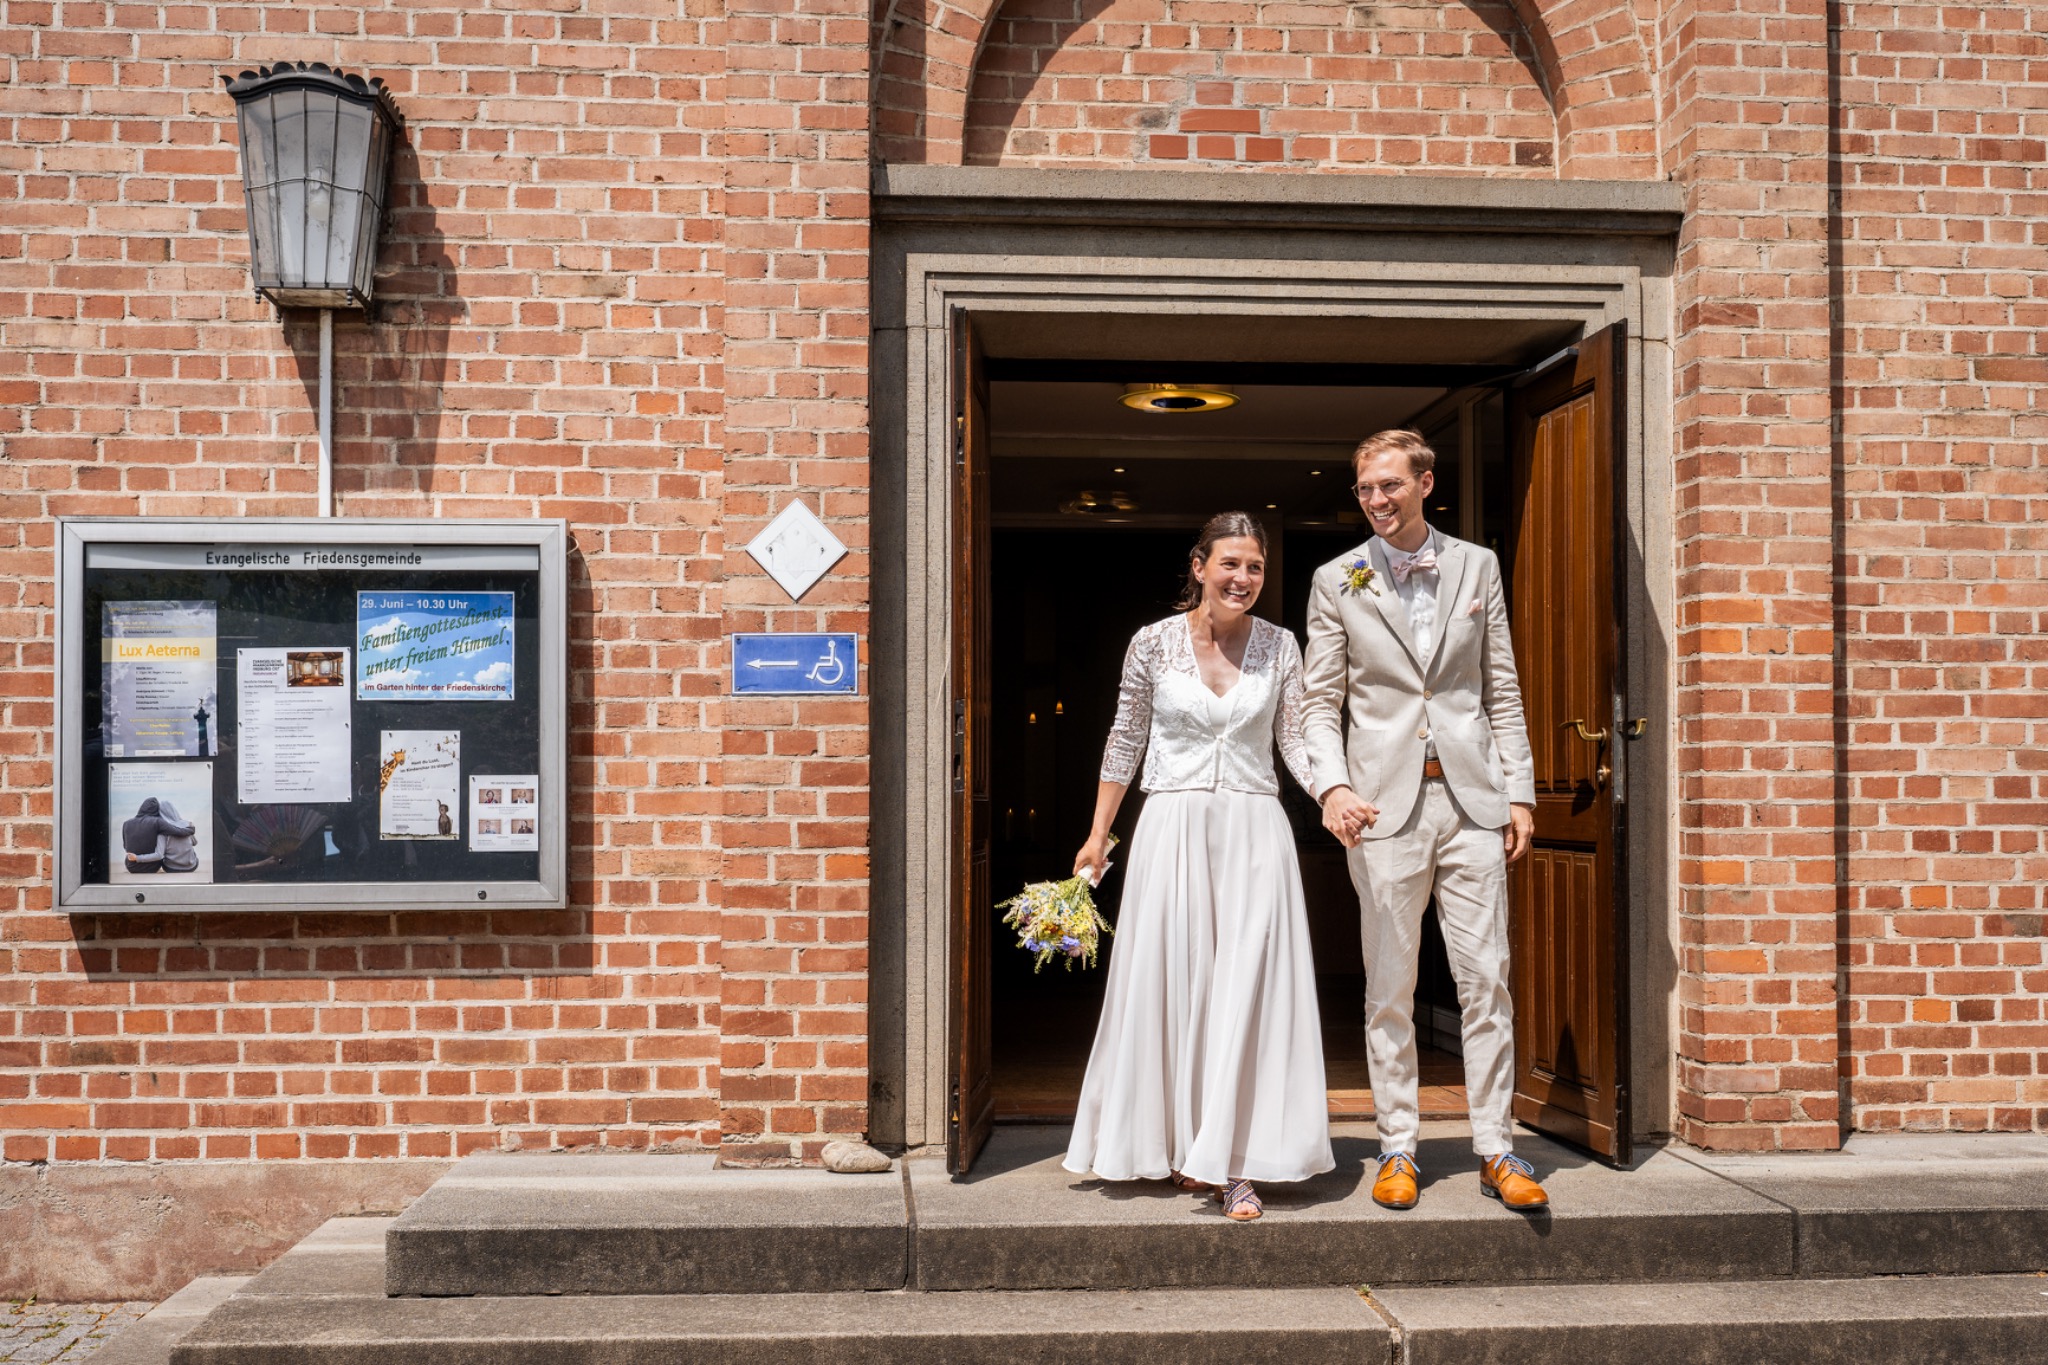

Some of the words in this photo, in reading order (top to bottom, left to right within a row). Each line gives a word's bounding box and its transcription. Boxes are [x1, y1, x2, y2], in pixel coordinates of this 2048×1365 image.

[206, 551, 290, 567] Evangelische
[303, 551, 422, 566] Friedensgemeinde
[361, 599, 377, 608] 29.
[380, 599, 404, 608] Juni
[417, 599, 445, 609] 10.30
[449, 599, 469, 608] Uhr
[361, 605, 508, 652] Familiengottesdienst-
[119, 644, 142, 657] Lux
[146, 644, 200, 657] Aeterna
[366, 656, 404, 676] unter
[402, 646, 449, 673] freiem
[450, 626, 508, 657] Himmel
[376, 684, 404, 692] Garten
[405, 684, 429, 692] hinter
[431, 684, 445, 692] der
[446, 684, 506, 692] Friedenskirche
